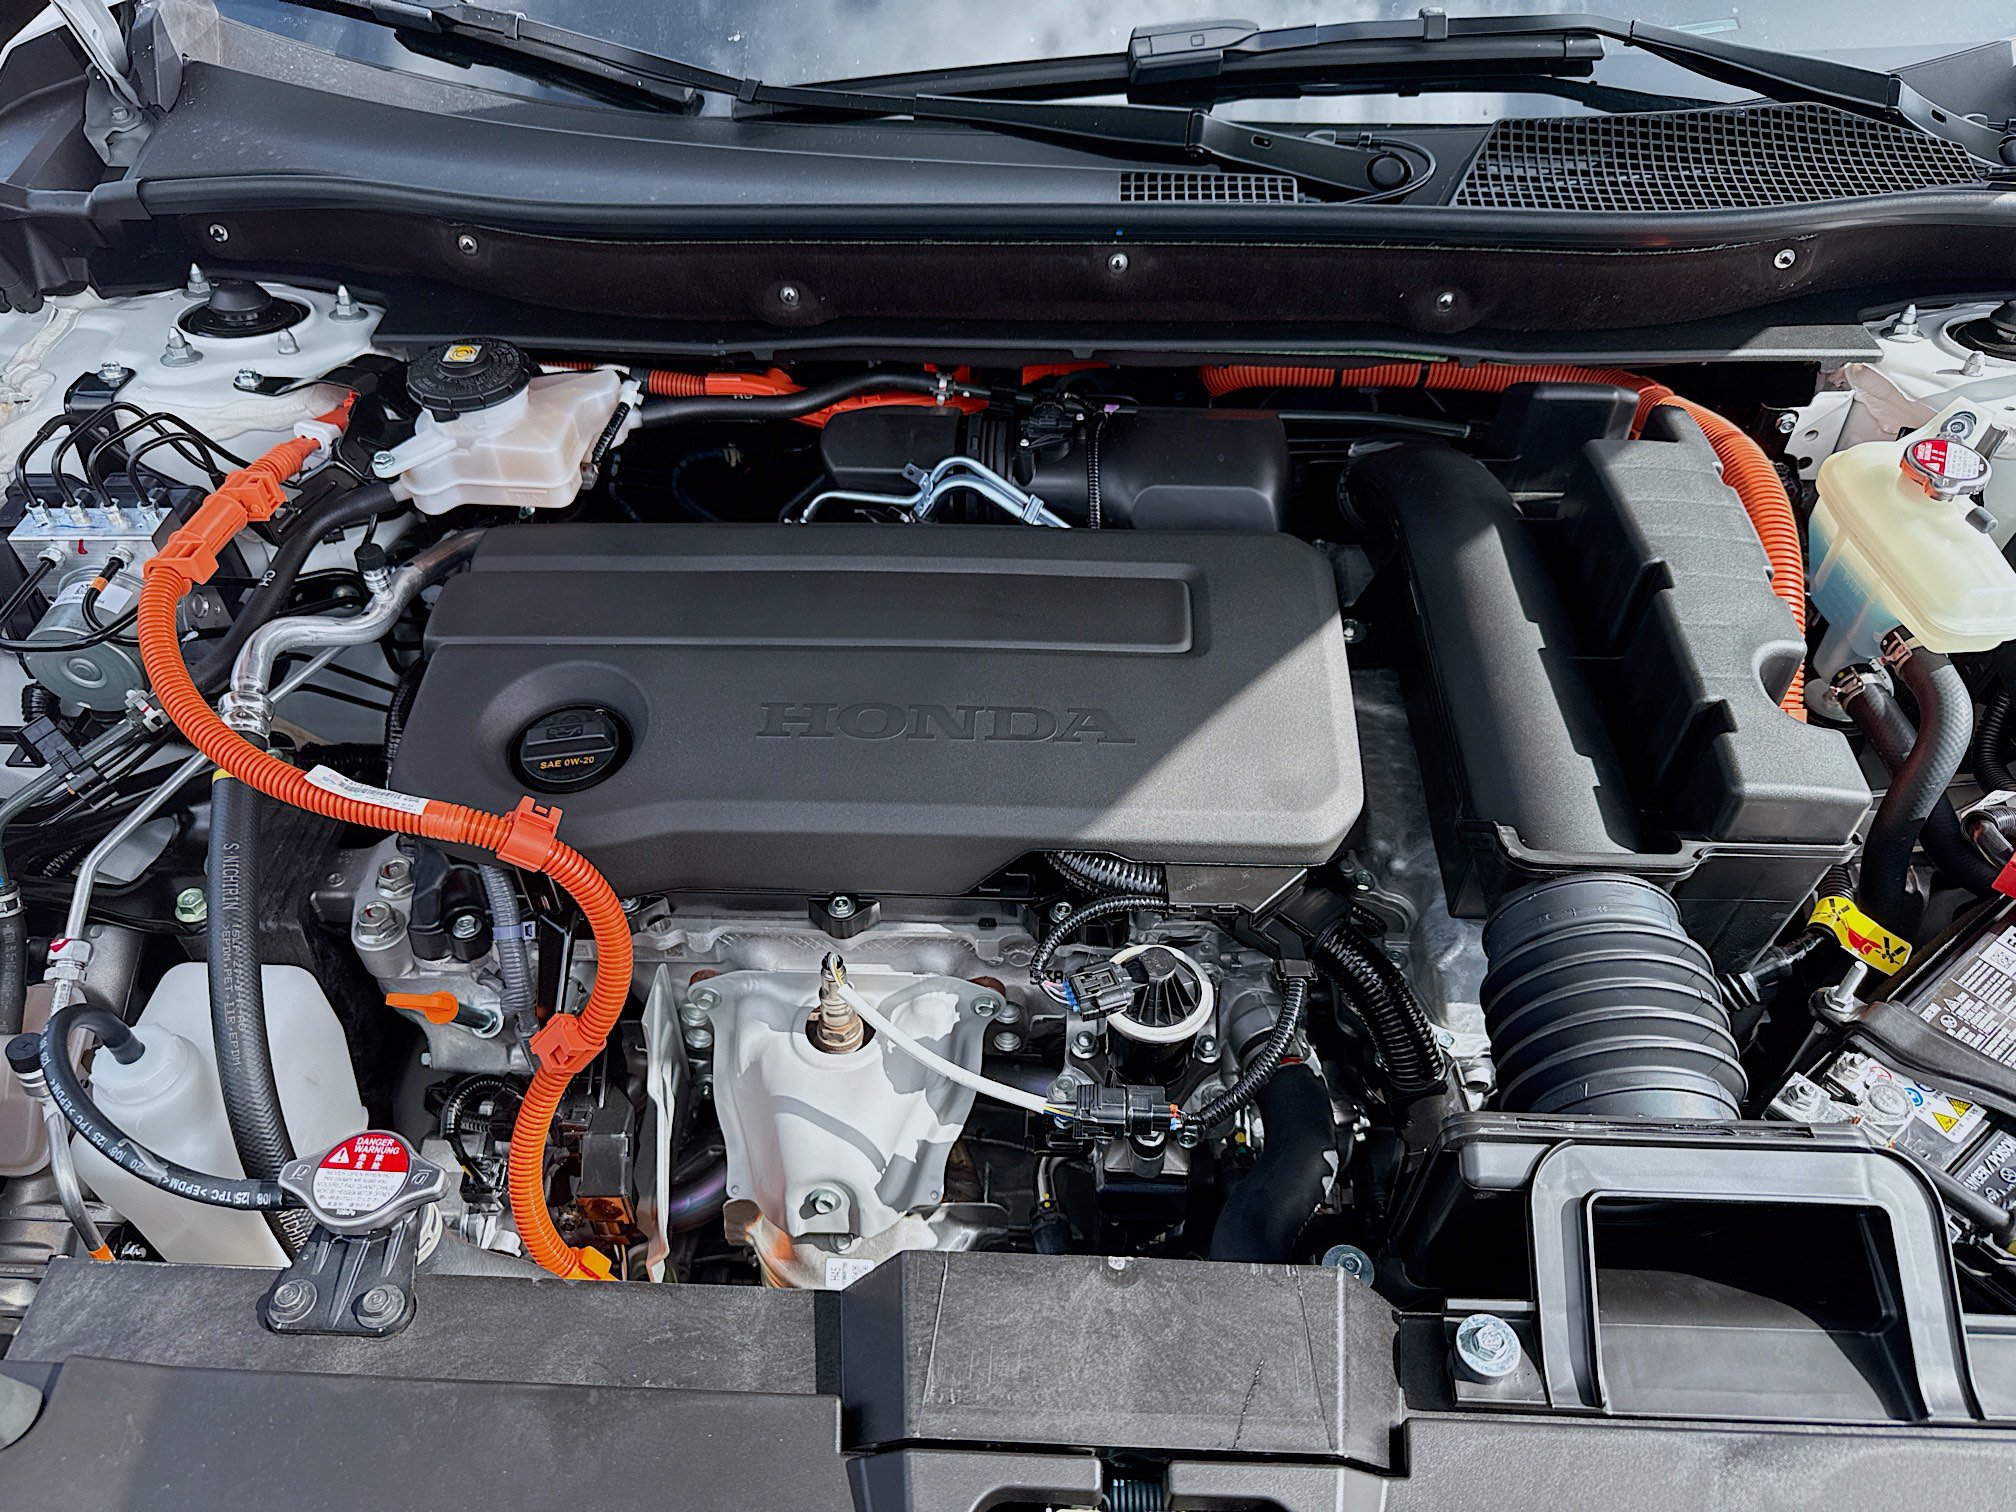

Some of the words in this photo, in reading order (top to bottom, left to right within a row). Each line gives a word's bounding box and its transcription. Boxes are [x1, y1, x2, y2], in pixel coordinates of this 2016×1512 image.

[756, 702, 1138, 746] HONDA
[540, 760, 561, 769] SAE
[564, 756, 595, 767] 0W-20
[50, 1077, 75, 1114] >EPDM<
[74, 1115, 95, 1137] TPC
[354, 1144, 400, 1155] WARNUNG
[356, 1136, 395, 1147] DANGER
[1962, 1136, 2016, 1191] ANGER/POISON
[160, 1175, 207, 1195] >EPDM<
[211, 1188, 233, 1202] TPC
[276, 1210, 308, 1252] NICHIR
